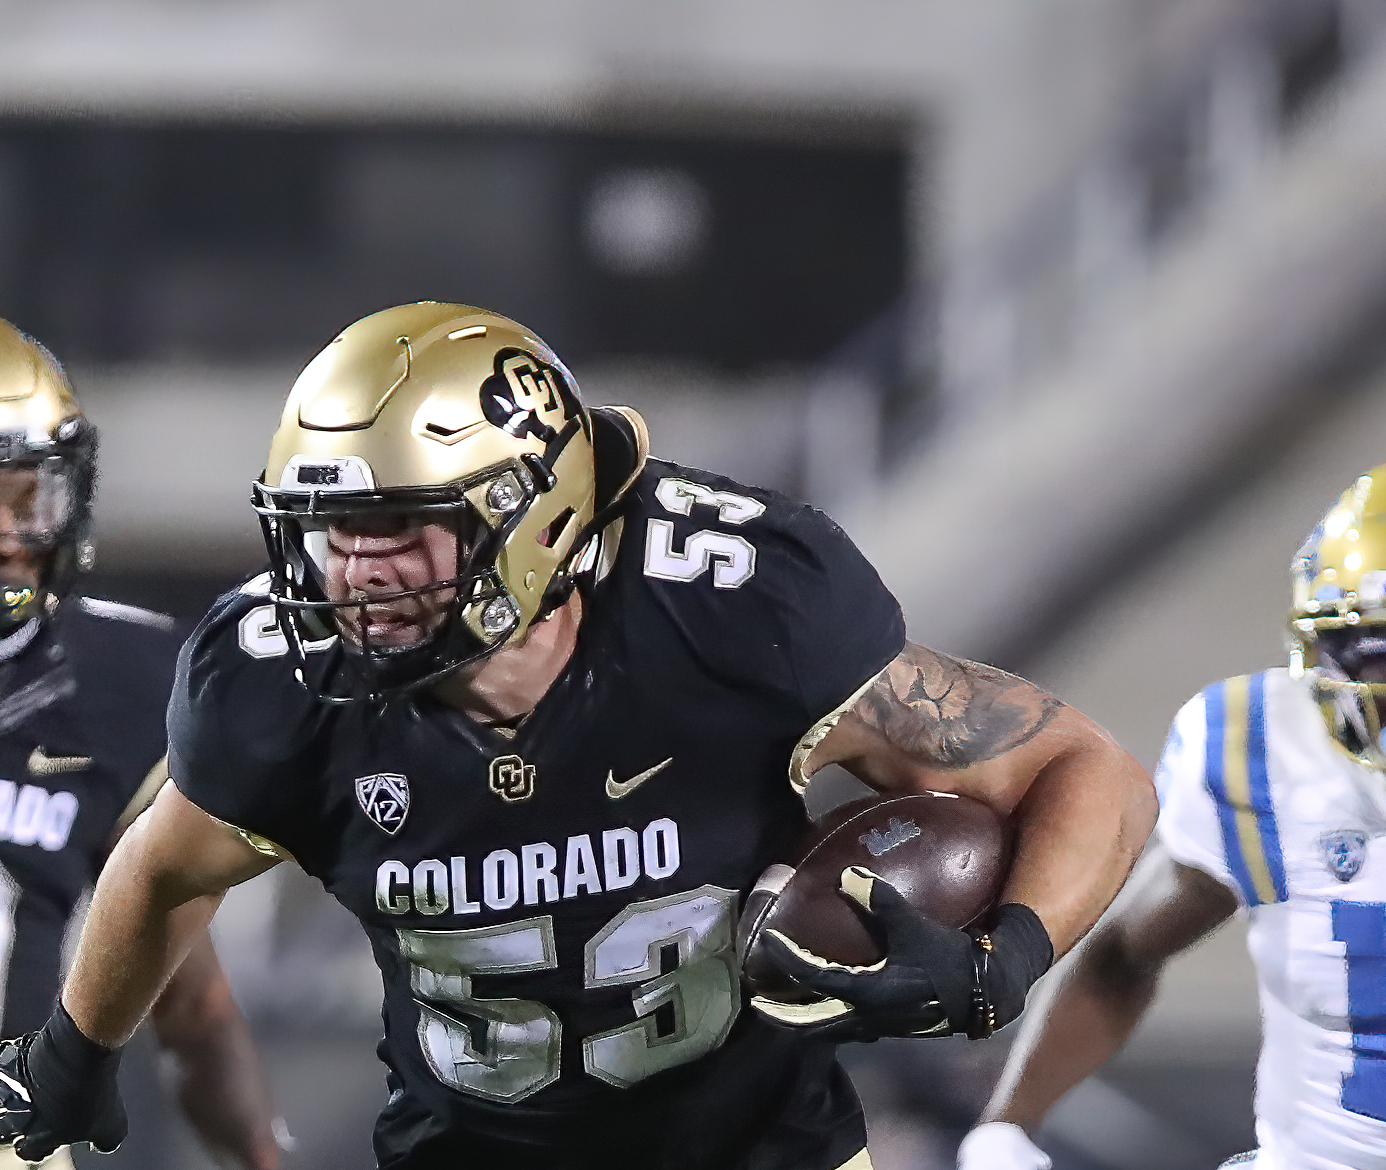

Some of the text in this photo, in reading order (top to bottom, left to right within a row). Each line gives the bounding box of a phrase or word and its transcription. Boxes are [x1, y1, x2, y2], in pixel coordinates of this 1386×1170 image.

[643, 475, 767, 591] 53
[375, 817, 681, 917] COLORADO
[396, 882, 743, 1105] 53
